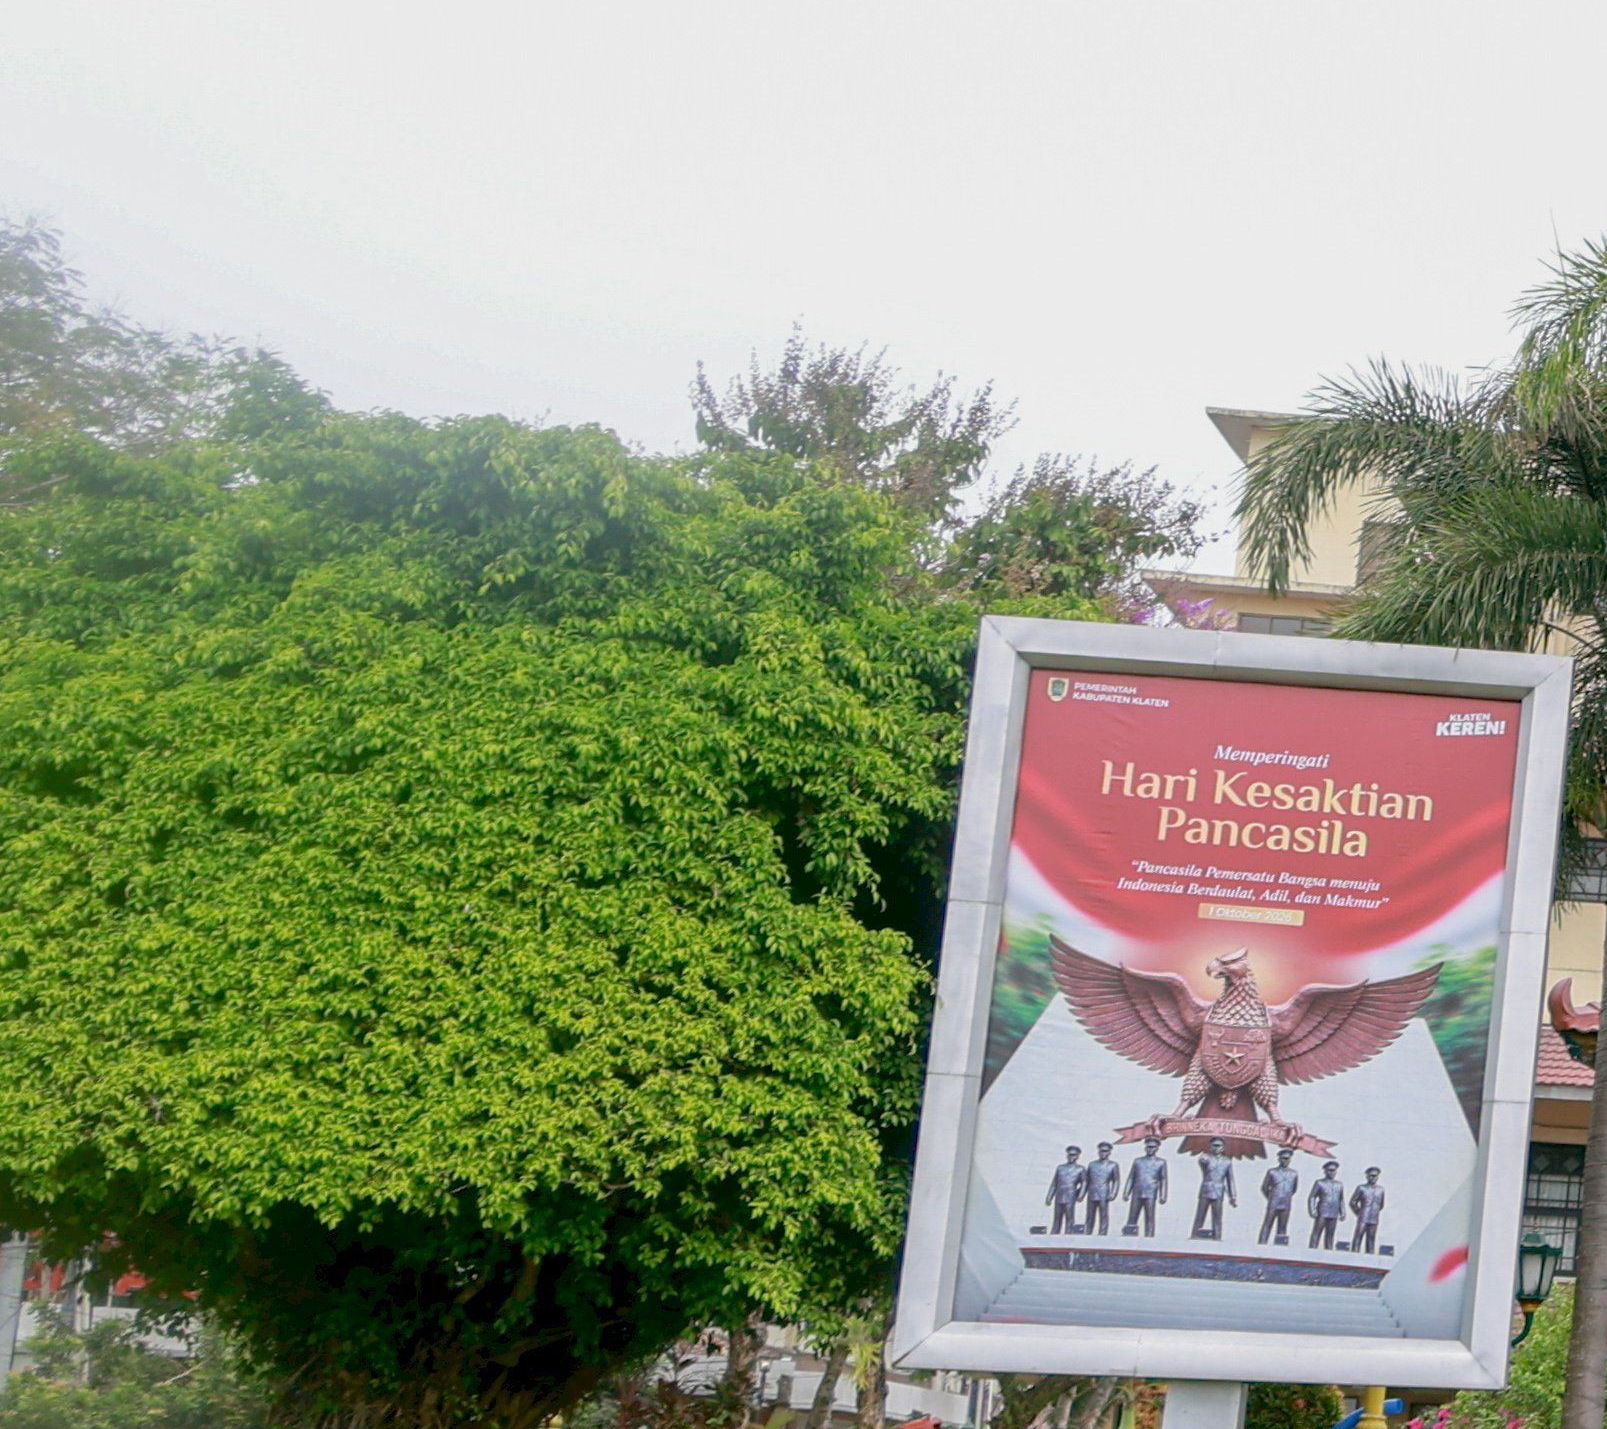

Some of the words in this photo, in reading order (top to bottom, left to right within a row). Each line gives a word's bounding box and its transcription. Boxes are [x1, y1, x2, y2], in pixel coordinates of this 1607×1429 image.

[1072, 692, 1130, 704] KABUPATEN
[1131, 697, 1169, 707] KLATEN
[1073, 682, 1137, 694] PEMERINTAH
[1435, 721, 1506, 736] KEREN!
[1449, 713, 1491, 721] KLATEN
[1213, 744, 1329, 769] Memperingati
[1101, 760, 1198, 802] Hari
[1213, 770, 1434, 822] Kesaktian
[1157, 805, 1368, 857] Pancasila
[1131, 859, 1202, 877] “Pancasila
[1205, 866, 1275, 883] Pemersatu
[1278, 871, 1327, 888] Bangsa
[1329, 879, 1381, 893] menuju
[1117, 877, 1184, 894] Indonesia
[1187, 882, 1256, 901] Berdaulat,
[1259, 889, 1291, 903] Adil,
[1294, 891, 1322, 905] dan
[1324, 893, 1390, 909] Makmur”
